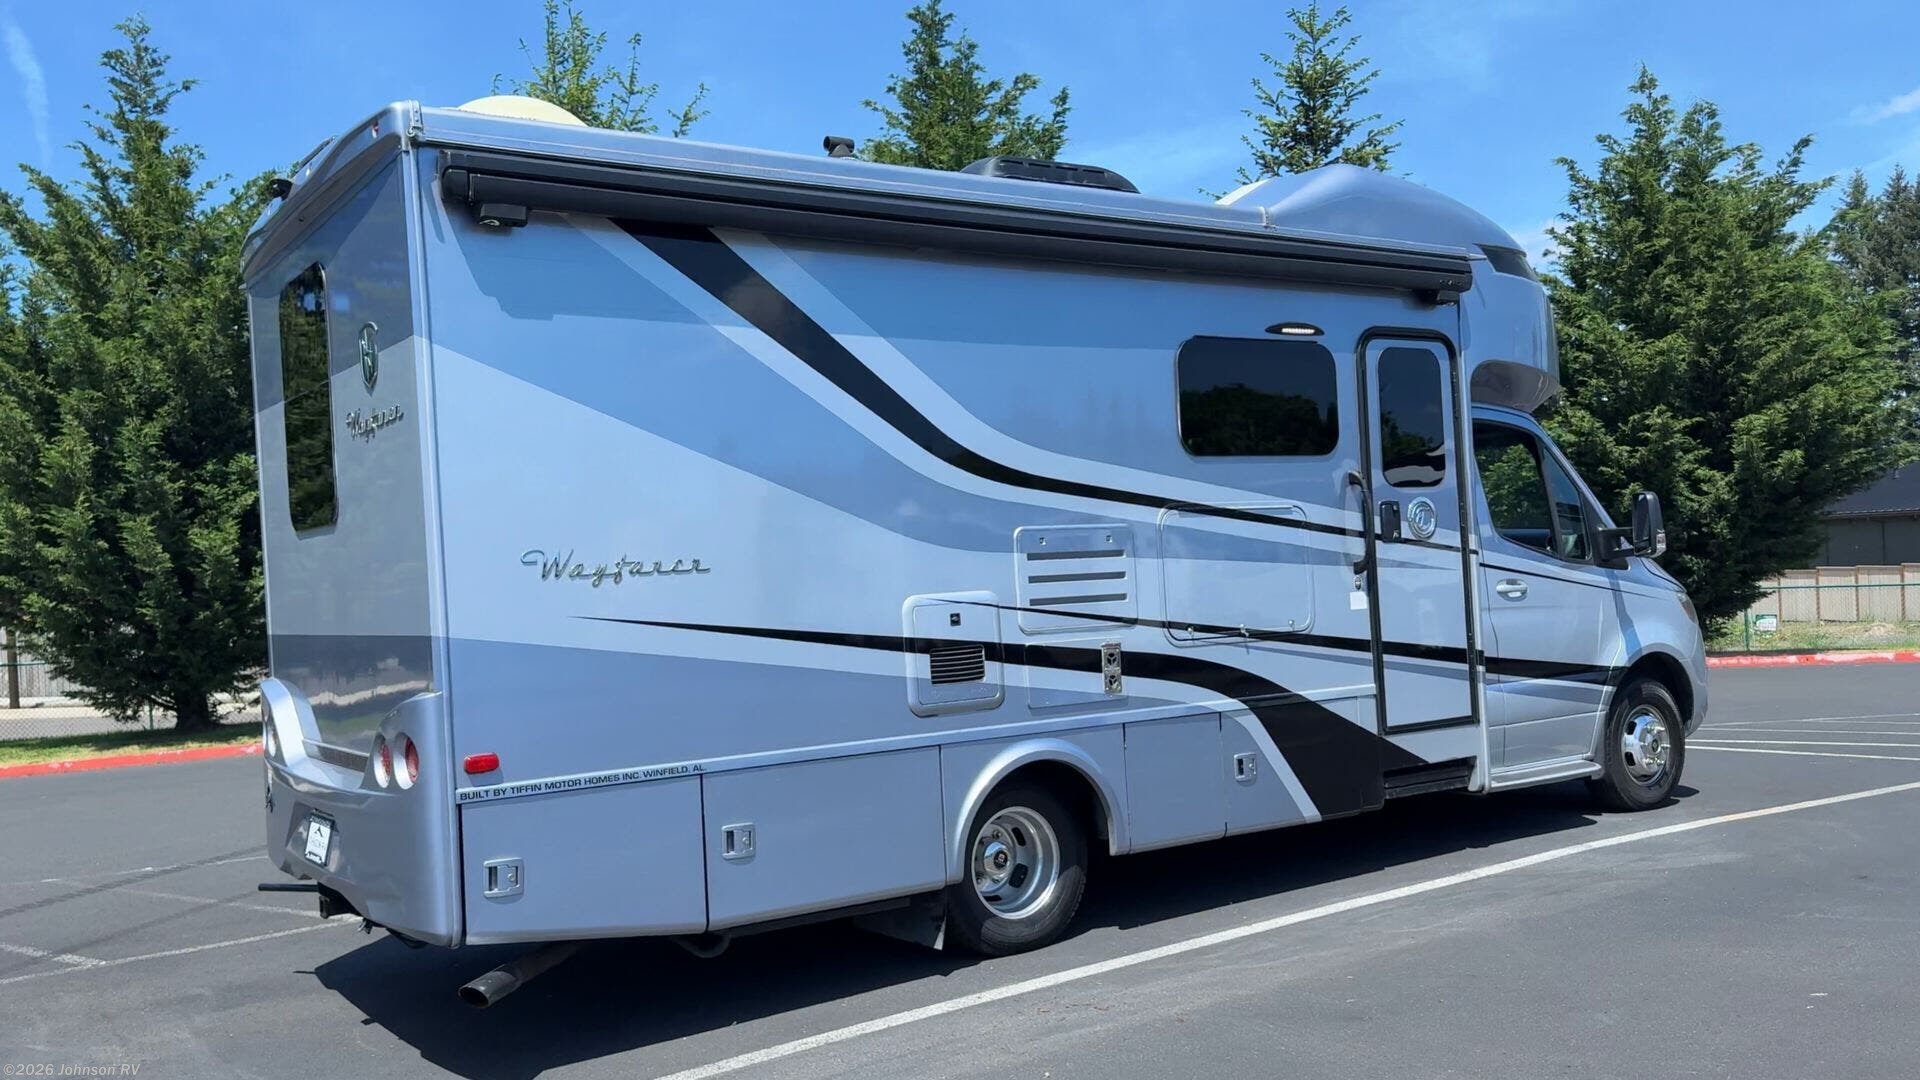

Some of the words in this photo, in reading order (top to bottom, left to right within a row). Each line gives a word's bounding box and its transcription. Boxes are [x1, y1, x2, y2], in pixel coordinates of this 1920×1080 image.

[520, 548, 711, 588] Wayfarer
[460, 789, 491, 801] BUILT
[493, 787, 508, 798] BY
[511, 783, 542, 795] TIFFIN
[544, 778, 582, 791] MOTOR
[584, 773, 620, 786] HOMES
[622, 771, 641, 781] INC.
